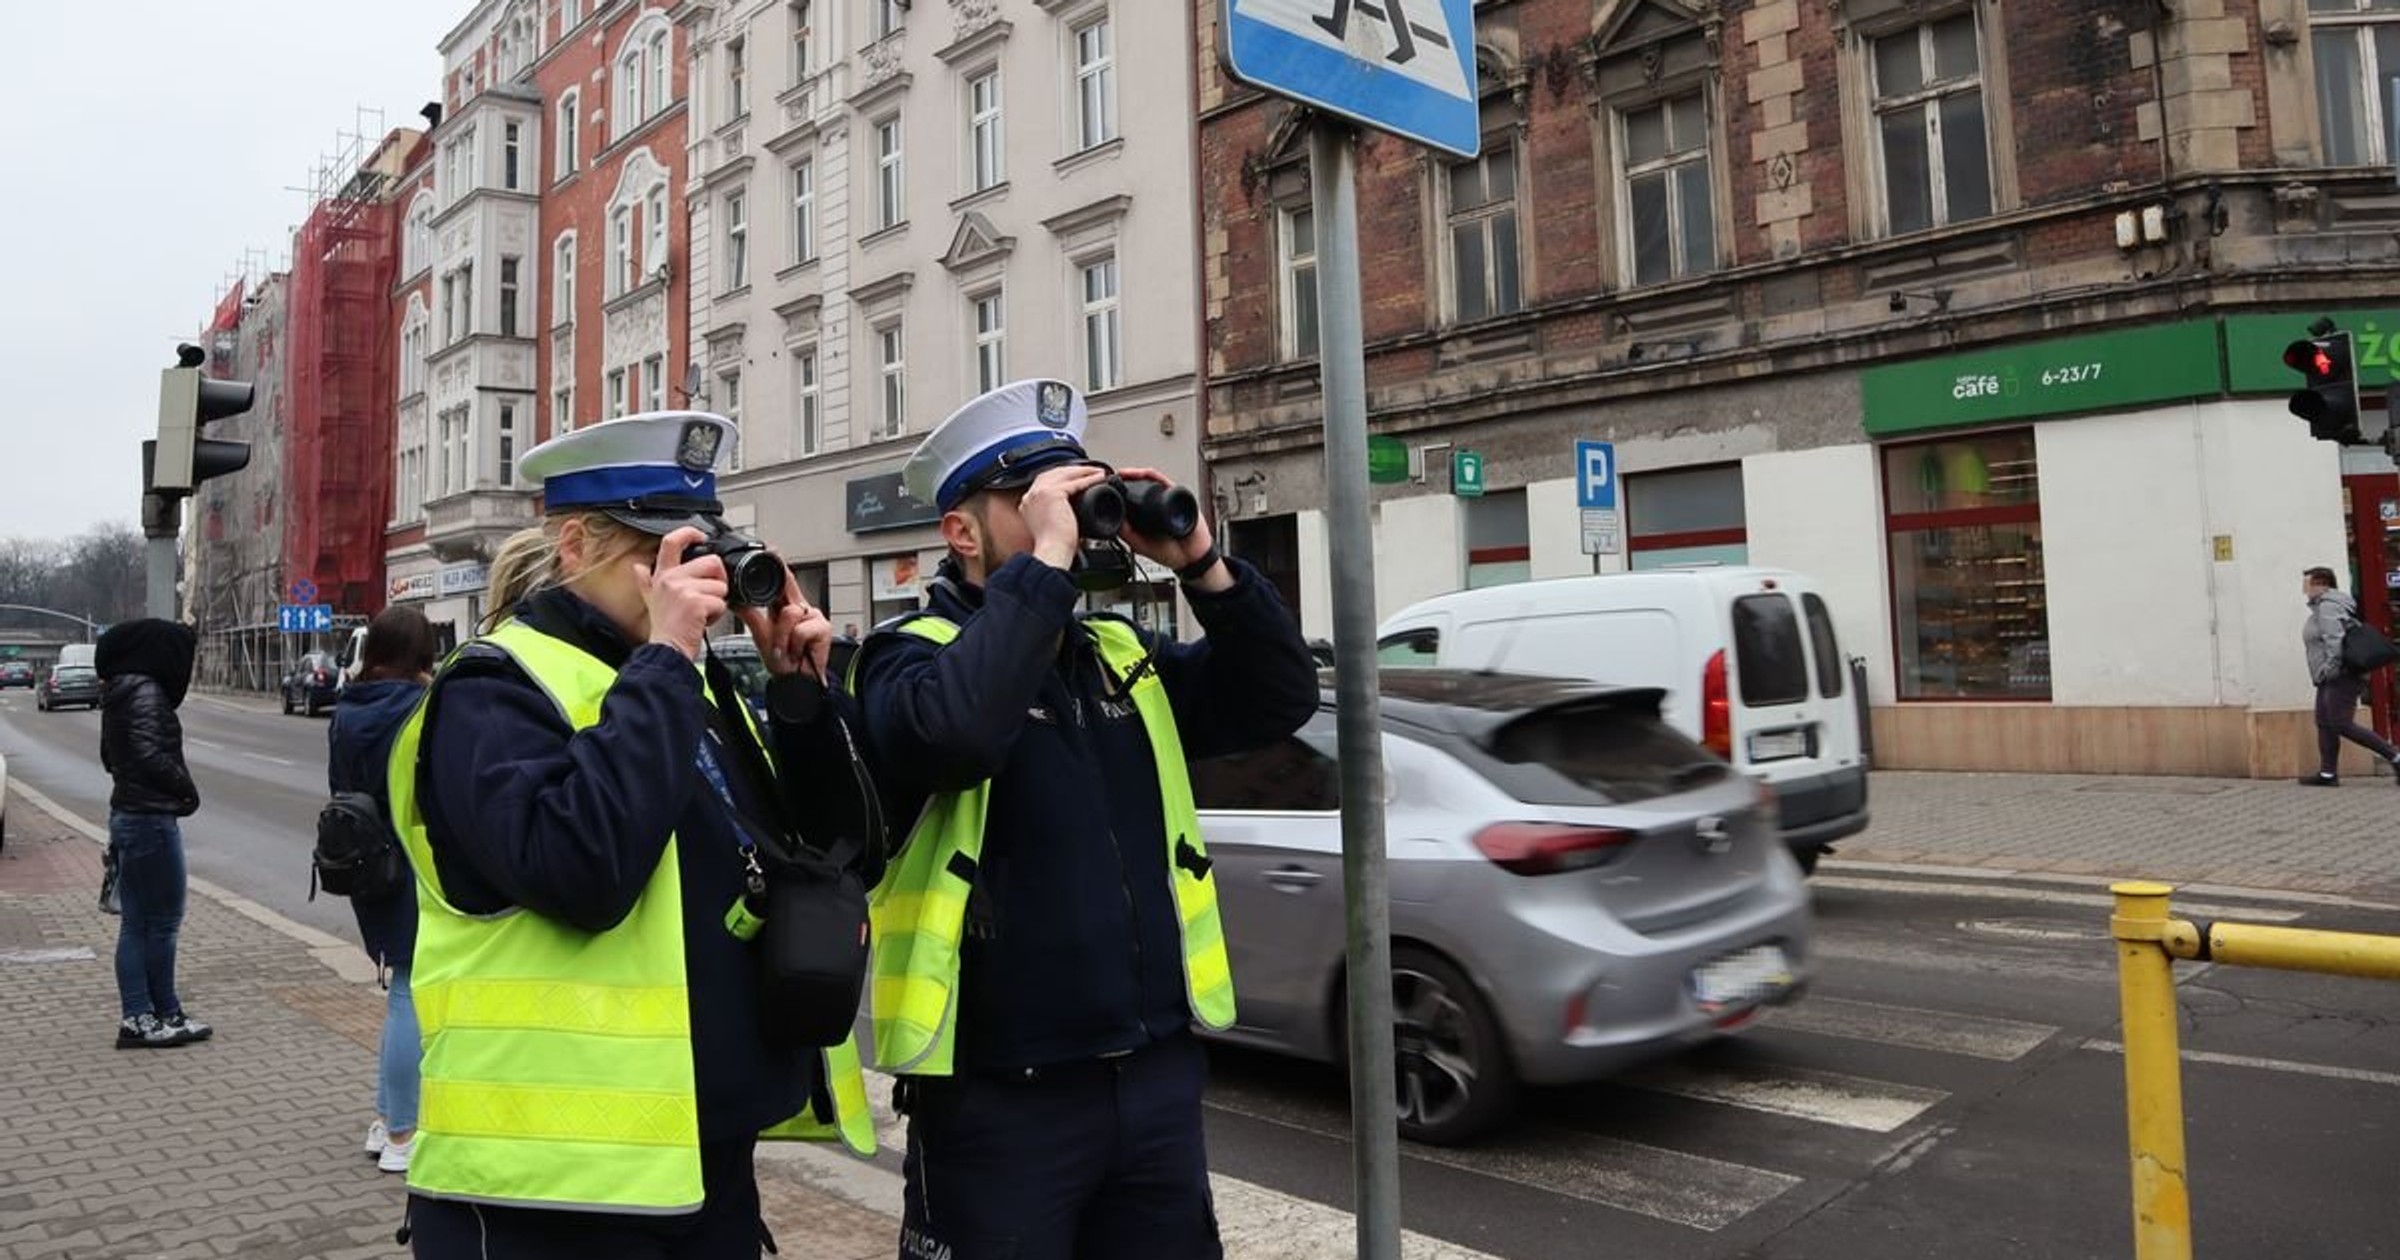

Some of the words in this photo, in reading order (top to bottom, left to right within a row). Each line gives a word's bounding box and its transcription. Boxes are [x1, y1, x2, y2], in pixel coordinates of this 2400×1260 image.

[1952, 376, 1999, 399] café
[2041, 364, 2101, 386] 6-23/7
[1585, 449, 1607, 500] P
[902, 1228, 951, 1260] POLICJA
